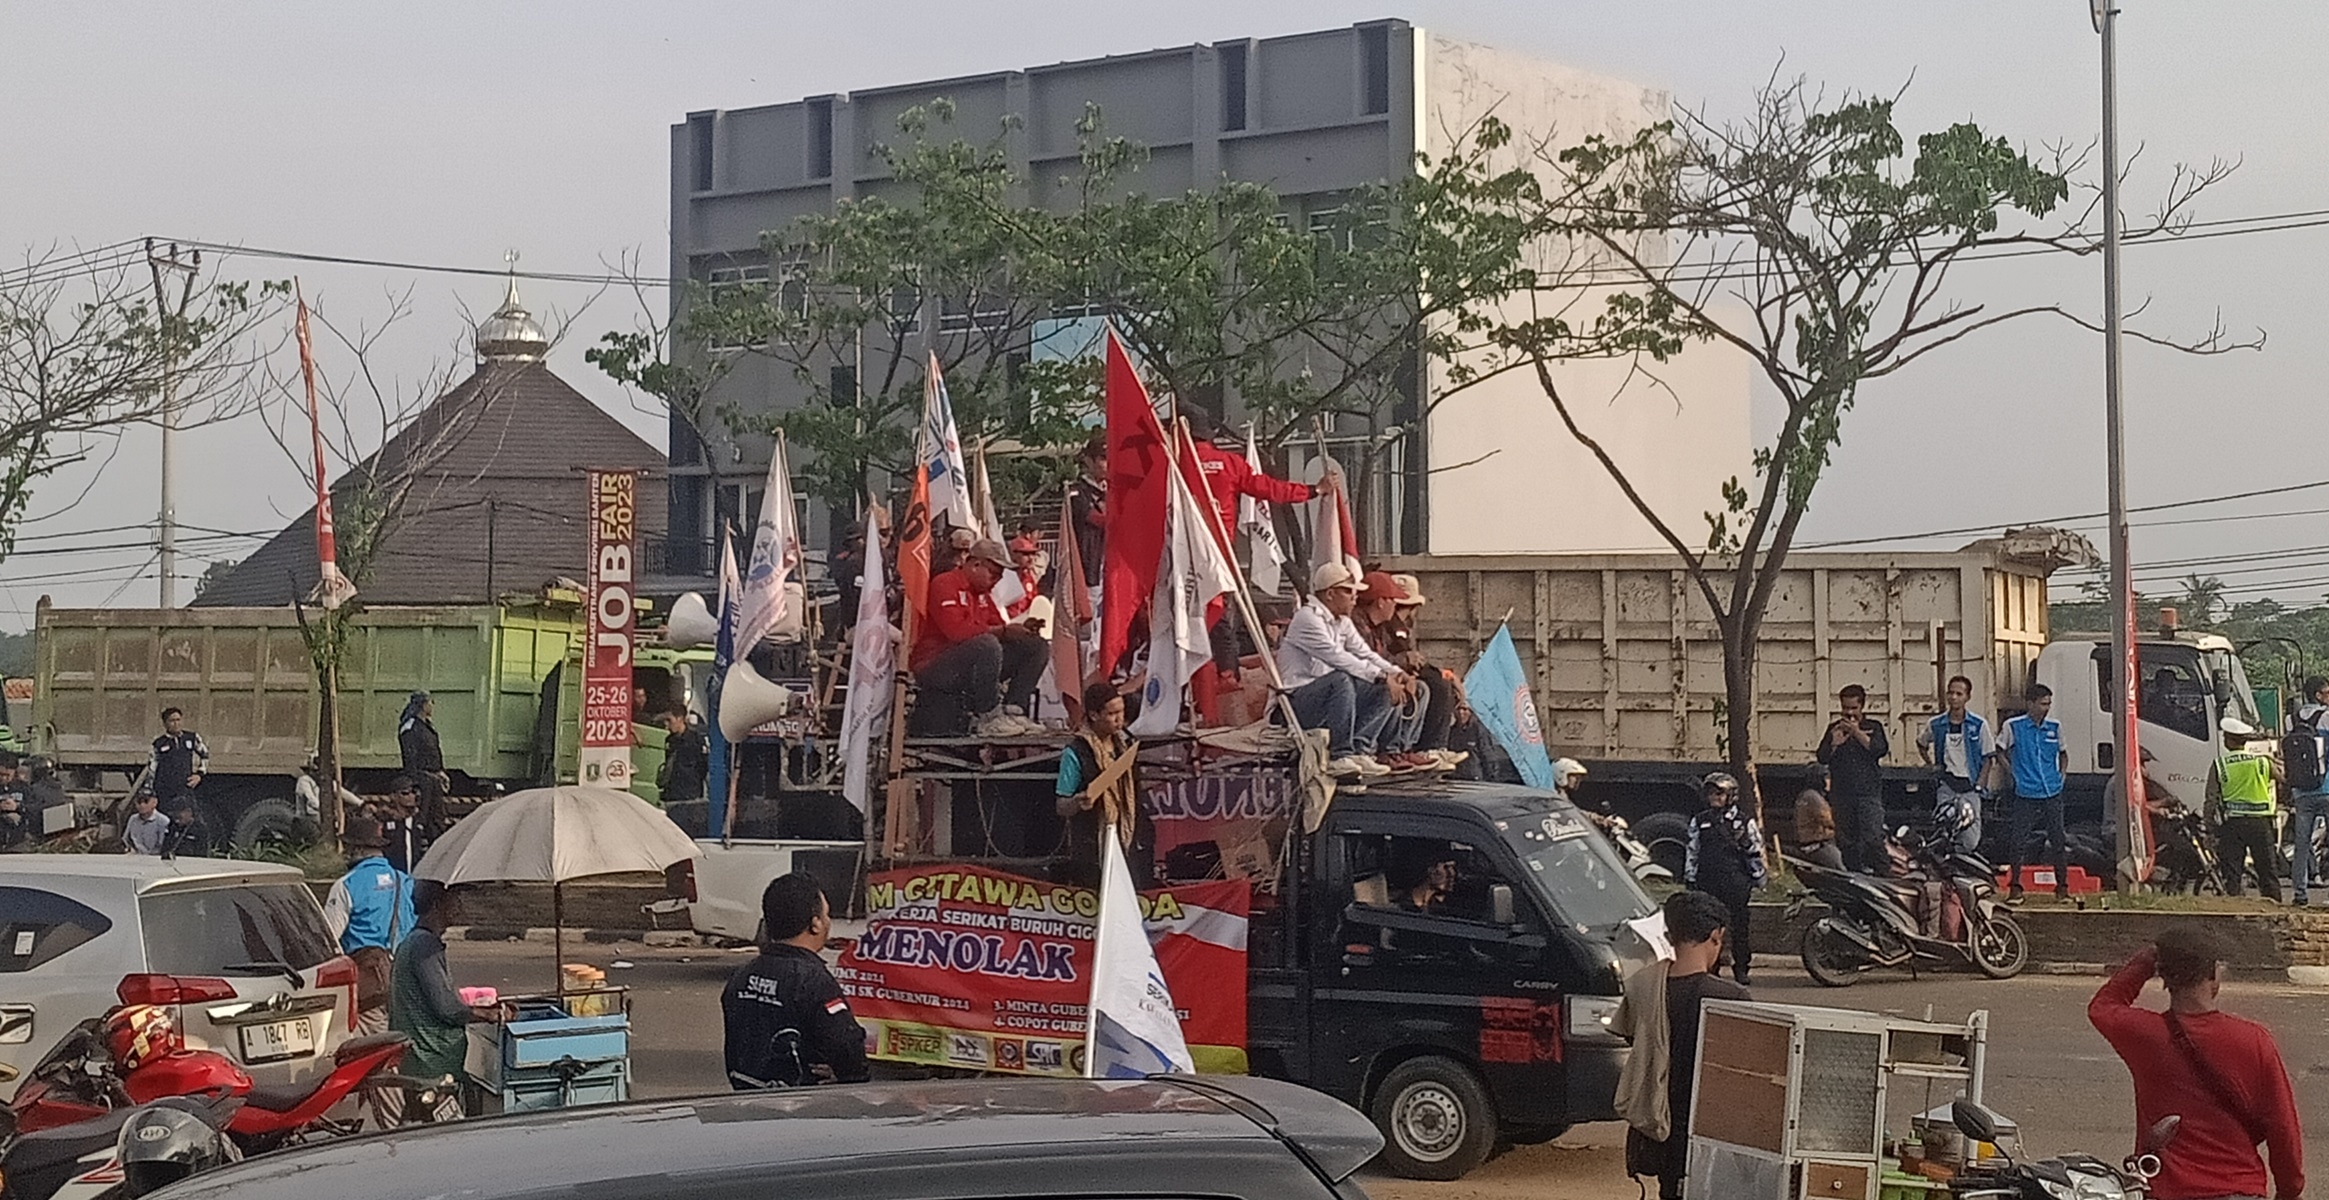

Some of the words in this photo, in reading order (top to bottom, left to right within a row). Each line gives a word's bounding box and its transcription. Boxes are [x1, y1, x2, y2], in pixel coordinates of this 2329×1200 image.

[591, 472, 600, 518] BANTEN
[600, 473, 618, 540] FAIR
[616, 474, 633, 540] 2023
[590, 520, 599, 573] PROVINSI
[598, 544, 632, 667] JOB
[588, 573, 599, 668] DISNAKERTRANS
[587, 686, 628, 704] 25-26
[586, 706, 628, 718] OKTOBER
[585, 720, 627, 741] 2023
[942, 911, 1008, 931] SERIKAT
[1011, 917, 1064, 937] BURUH
[854, 924, 1077, 982] MENOLAK
[858, 987, 873, 998] SK
[876, 988, 941, 1007] GUBERNUR
[1513, 980, 1559, 989] CARRY
[1007, 1001, 1048, 1014] MINTA
[1050, 1003, 1088, 1016] GUBE
[246, 1028, 254, 1047] A
[263, 1023, 288, 1045] 1847
[295, 1021, 309, 1040] RB
[1007, 1016, 1048, 1029] COPOT
[1051, 1019, 1088, 1032] GUBE
[899, 1036, 941, 1054] SPKEP
